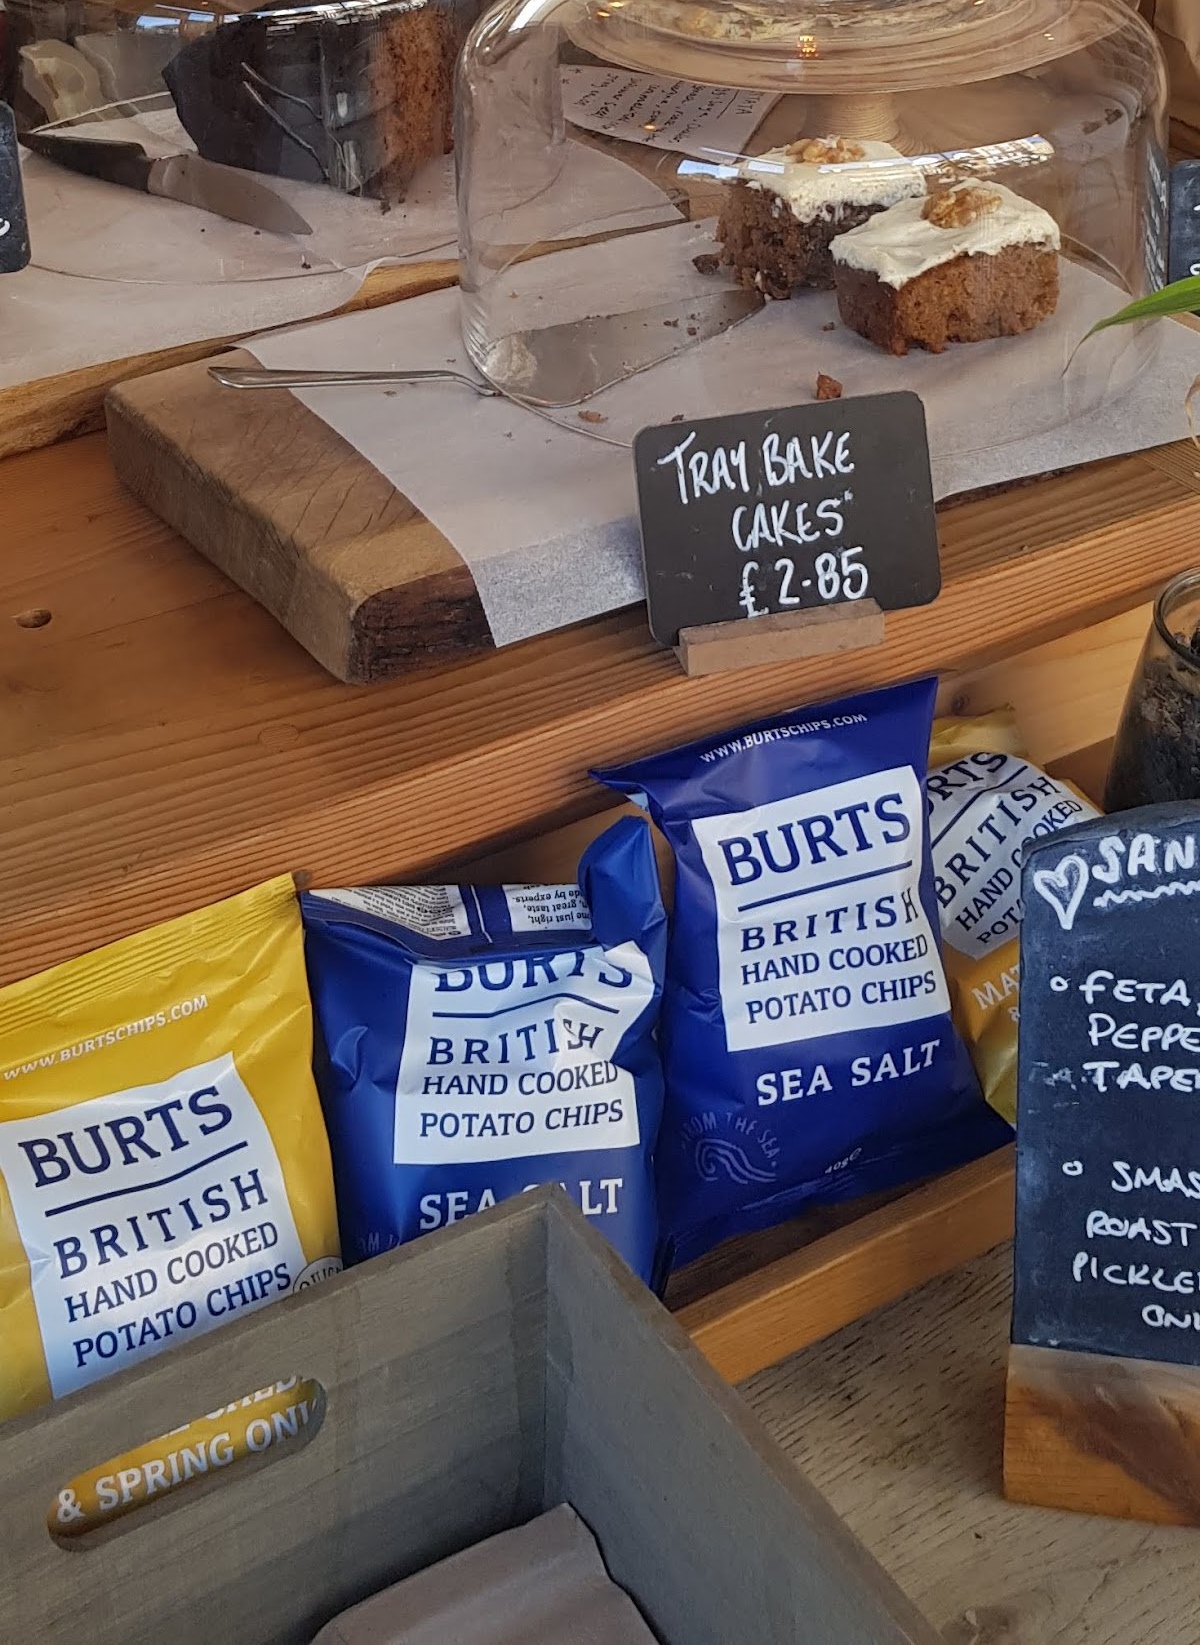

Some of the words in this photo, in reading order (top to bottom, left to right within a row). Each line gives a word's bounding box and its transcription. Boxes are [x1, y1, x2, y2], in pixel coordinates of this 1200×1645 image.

[657, 431, 750, 504] TRAY
[762, 430, 855, 487] BAKE
[732, 500, 844, 552] CAKES
[699, 713, 868, 764] WWW.BURTSCHIPS.COM
[717, 792, 912, 887] BURTS
[933, 776, 1062, 909] BRITISH
[1092, 833, 1196, 884] SAN
[523, 904, 551, 913] taste,
[527, 914, 554, 925] right,
[552, 899, 577, 913] great
[555, 890, 567, 900] by
[556, 911, 575, 923] just
[741, 887, 919, 953] BRITISH
[956, 867, 1014, 932] HAND
[741, 953, 820, 986] HAND
[829, 934, 929, 970] COOKED
[745, 985, 851, 1024] POTATO
[861, 970, 937, 1005] CHIPS
[2, 994, 209, 1081] WWW.BURTSCHIPS.COM
[426, 1018, 604, 1066] BRITISH
[421, 1073, 508, 1096] HAND
[518, 1060, 619, 1096] COOKED
[756, 1064, 833, 1106] SEA
[851, 1038, 942, 1088] SALT
[1082, 1061, 1200, 1093] TAPE
[18, 1085, 233, 1189] BURTS
[419, 1110, 535, 1138] POTATO
[545, 1099, 624, 1131] CHIPS
[53, 1168, 268, 1280] BRITISH
[1086, 1210, 1198, 1247] ROAST
[64, 1268, 158, 1323] HAND
[167, 1221, 279, 1285] COOKED
[1072, 1251, 1200, 1294] PICKLE
[72, 1301, 197, 1368] POTATO
[206, 1262, 292, 1317] CHIPS
[57, 1488, 86, 1523] &
[94, 1432, 235, 1512] SPRING
